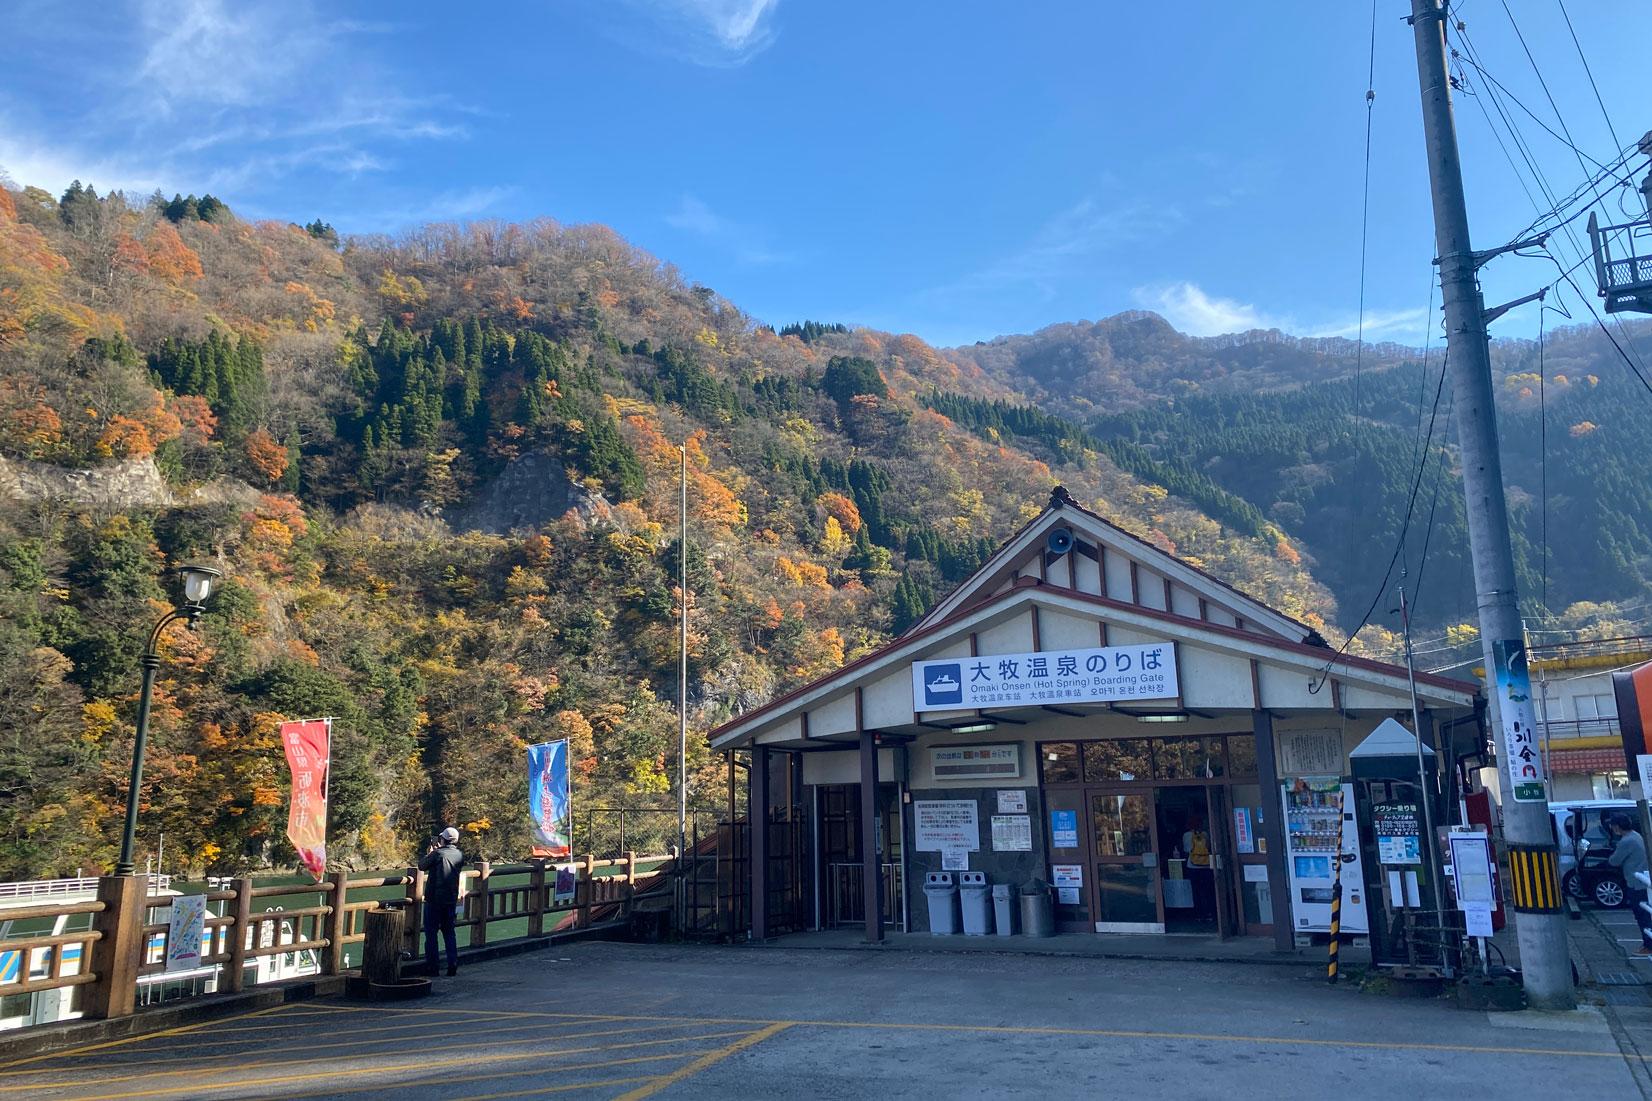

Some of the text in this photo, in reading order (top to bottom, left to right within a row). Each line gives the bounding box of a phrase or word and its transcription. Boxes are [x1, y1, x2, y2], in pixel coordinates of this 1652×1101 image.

[970, 648, 1163, 682] 大牧温泉のりば
[970, 673, 1164, 693] Omaki Onsen (Hot Spring) Boarding Gate
